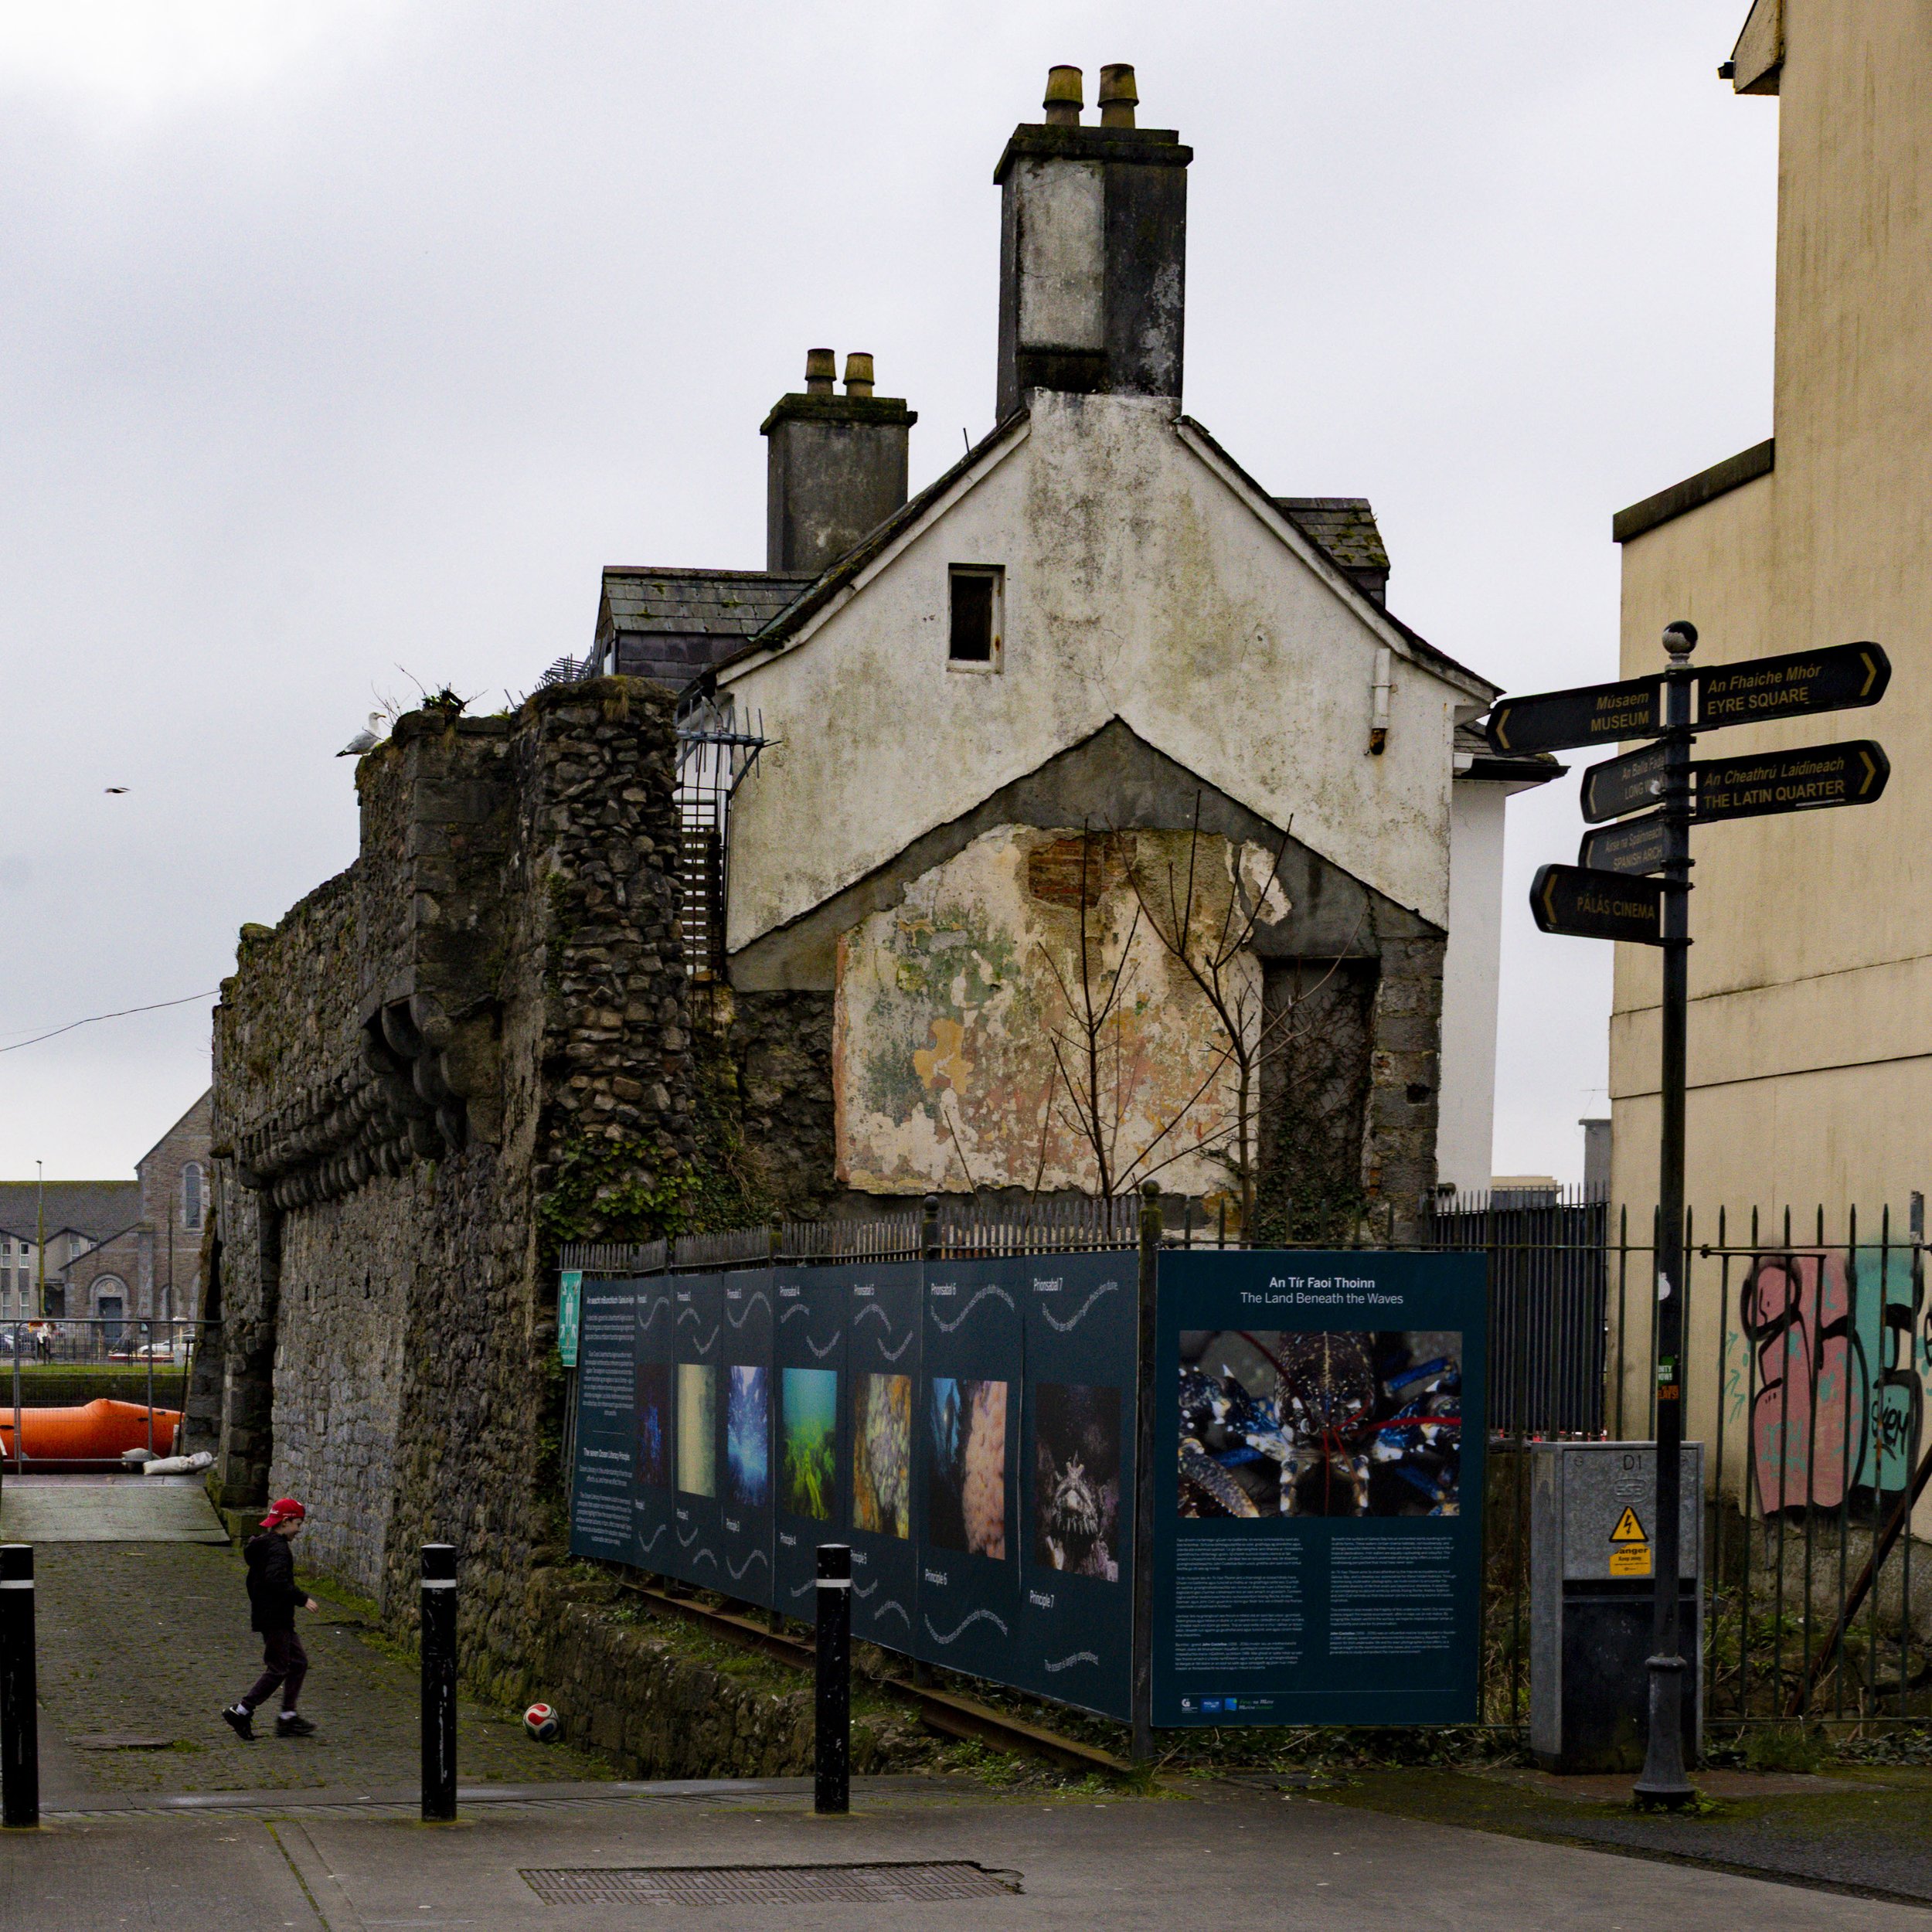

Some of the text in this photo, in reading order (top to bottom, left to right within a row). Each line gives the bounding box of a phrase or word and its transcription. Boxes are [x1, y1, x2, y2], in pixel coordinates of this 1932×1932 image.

[1707, 662, 1822, 694] An Fhaiche Mhór
[1595, 692, 1650, 710] Músaem
[1706, 686, 1809, 716] EYRE SQUARE
[1590, 710, 1650, 733] MUSEUM
[1703, 756, 1845, 787] An Cheathrú Laidineach
[1624, 781, 1644, 800] LONG
[1703, 780, 1845, 809] THE LATIN QUARTER
[1613, 844, 1663, 871] SPANISH ARCH
[1613, 900, 1655, 920] CINEMA
[1058, 1277, 1063, 1291] 7
[1269, 1277, 1376, 1288] An Tír Faoi Thoinn
[1240, 1291, 1403, 1304] The Land Beneath the Waves
